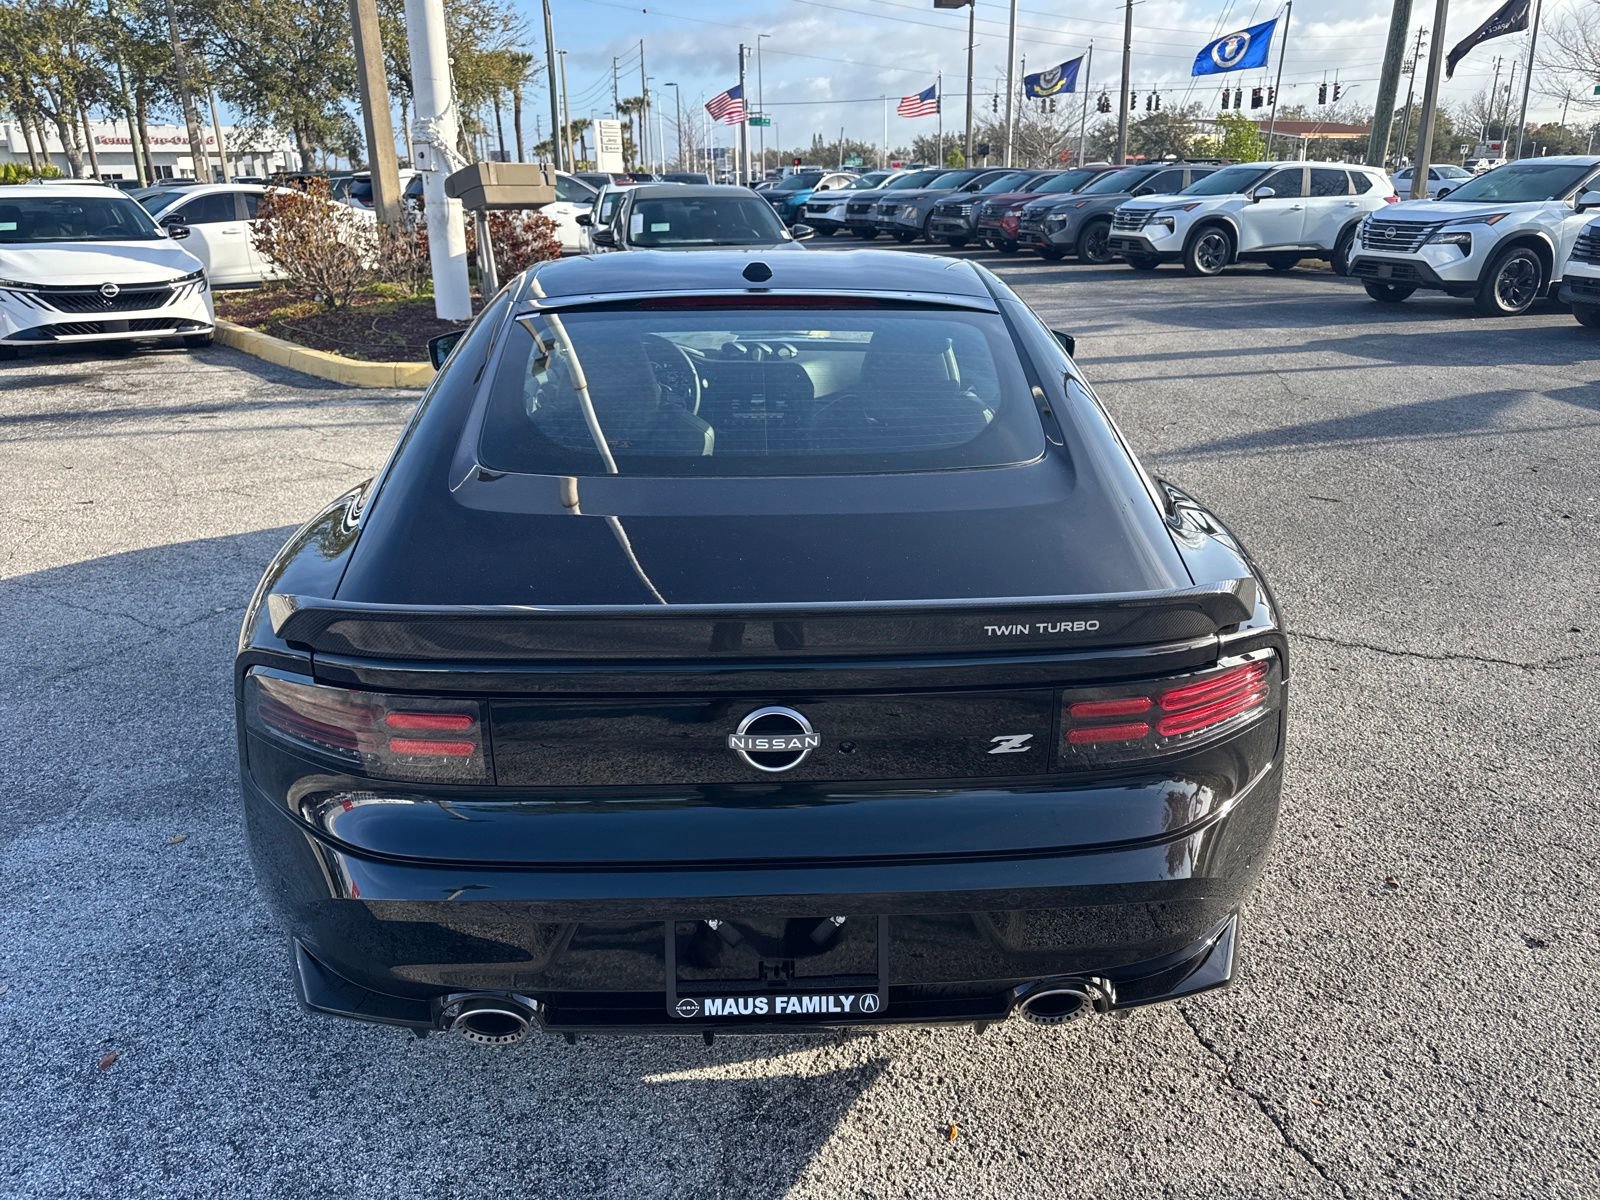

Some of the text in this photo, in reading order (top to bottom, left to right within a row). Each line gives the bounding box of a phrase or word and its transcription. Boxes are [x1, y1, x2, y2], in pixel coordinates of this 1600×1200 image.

[984, 620, 1100, 636] TWIN TURBO
[731, 735, 818, 749] NISSAN
[987, 733, 1034, 754] Z
[704, 995, 856, 1016] MAUS FAMILY
